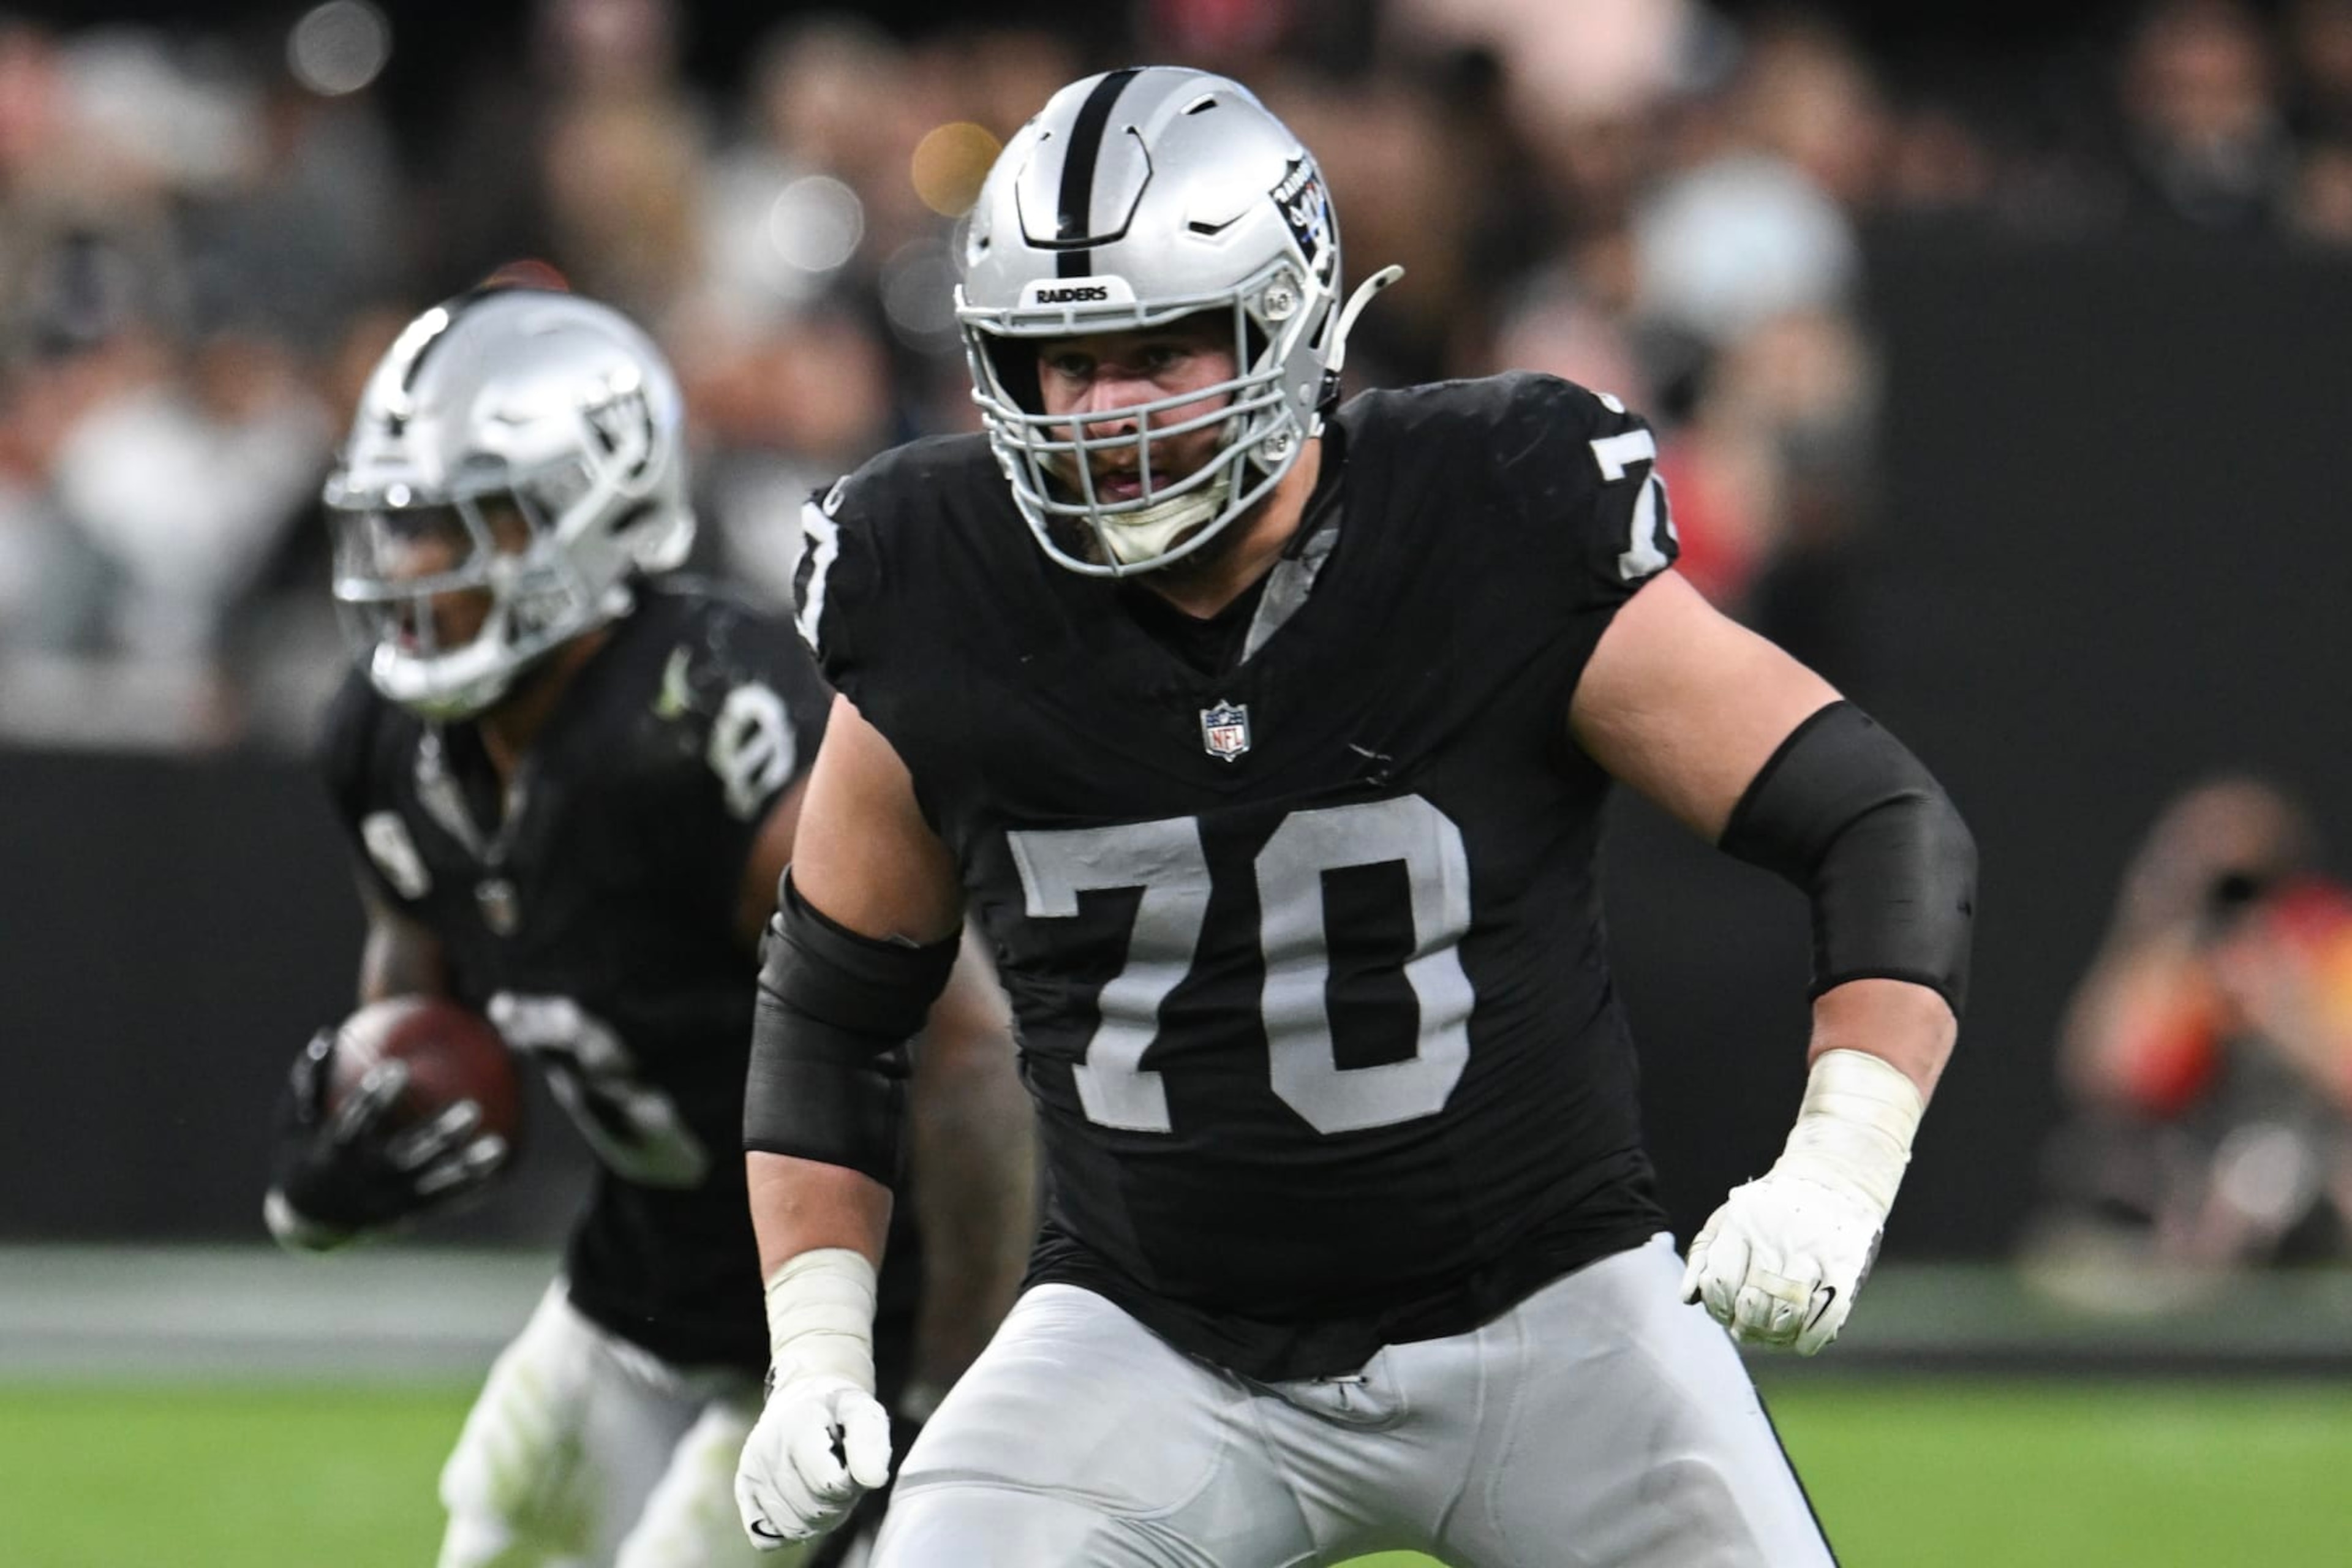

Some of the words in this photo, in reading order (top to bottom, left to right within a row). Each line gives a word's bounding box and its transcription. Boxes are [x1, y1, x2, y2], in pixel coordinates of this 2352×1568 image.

[1037, 286, 1108, 304] RAIDERS
[1211, 728, 1243, 750] NFL
[1006, 793, 1475, 1134] 70
